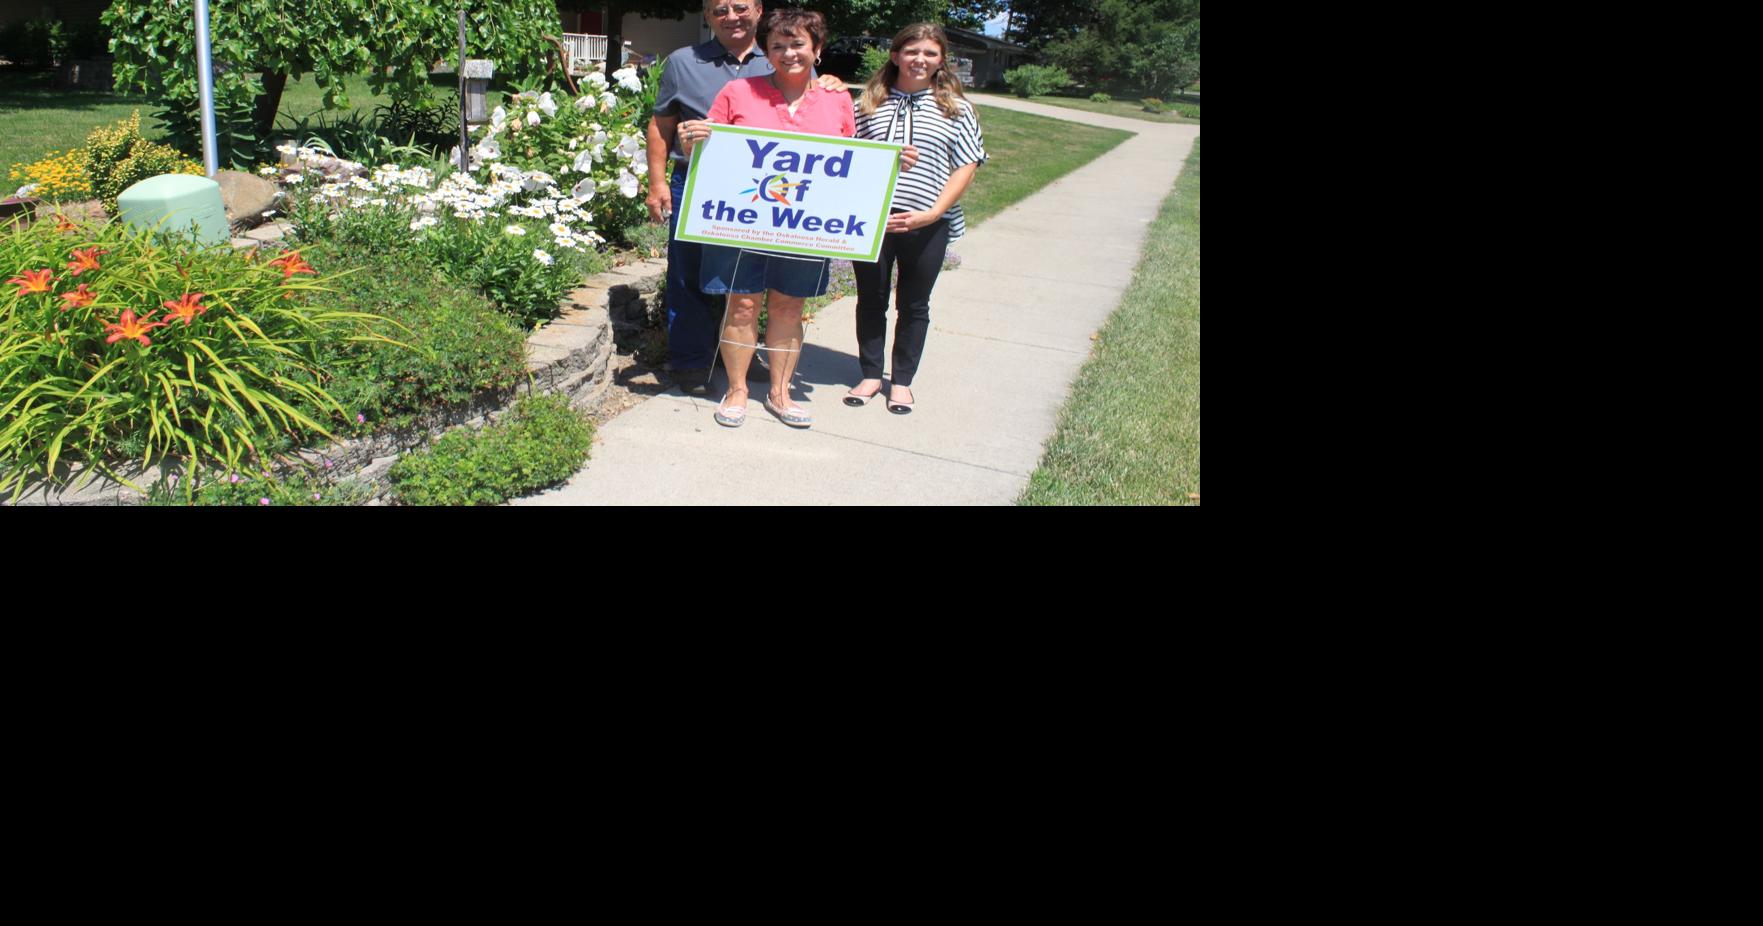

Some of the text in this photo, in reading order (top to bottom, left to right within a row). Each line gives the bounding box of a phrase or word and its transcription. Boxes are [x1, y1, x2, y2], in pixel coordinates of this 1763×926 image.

[746, 139, 854, 178] Yard
[759, 174, 812, 203] Of
[702, 200, 867, 237] the Week
[712, 224, 751, 233] Sponsored
[752, 228, 761, 236] by
[763, 229, 775, 237] the
[776, 231, 814, 240] Oskaloosa
[815, 236, 840, 244] Herald
[741, 234, 773, 242] Chamber
[775, 238, 814, 246] Commerce
[816, 242, 855, 251] Committee
